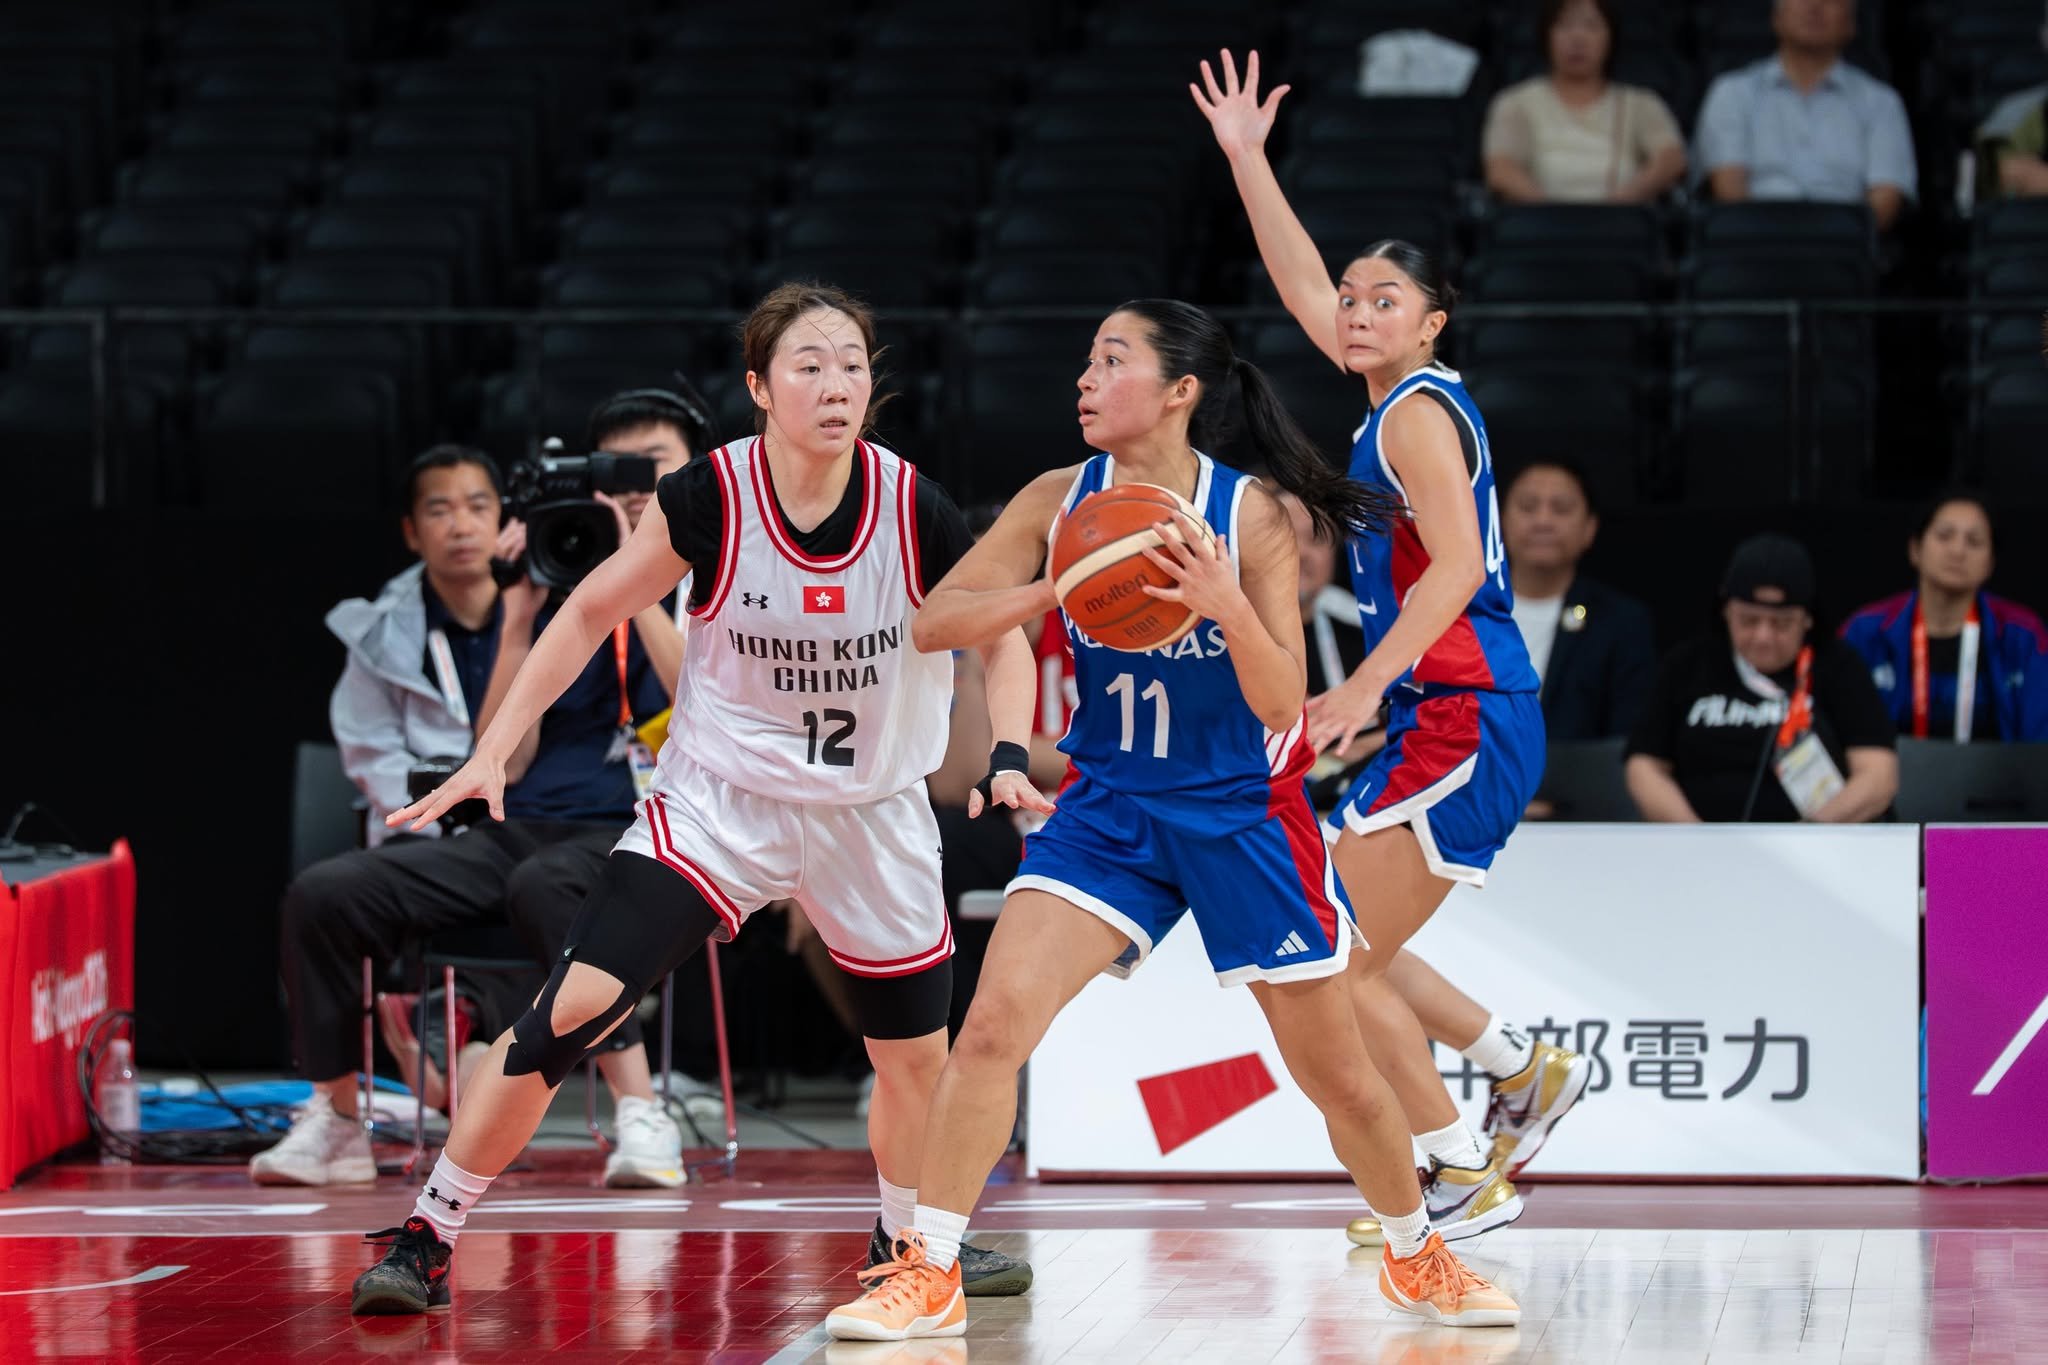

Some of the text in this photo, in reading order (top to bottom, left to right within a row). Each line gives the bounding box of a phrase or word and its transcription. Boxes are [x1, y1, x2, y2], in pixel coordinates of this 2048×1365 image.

[1084, 573, 1149, 614] molten
[728, 616, 904, 662] HONG KON
[774, 665, 879, 693] CHINA
[803, 708, 856, 767] 12
[1105, 672, 1170, 759] 11
